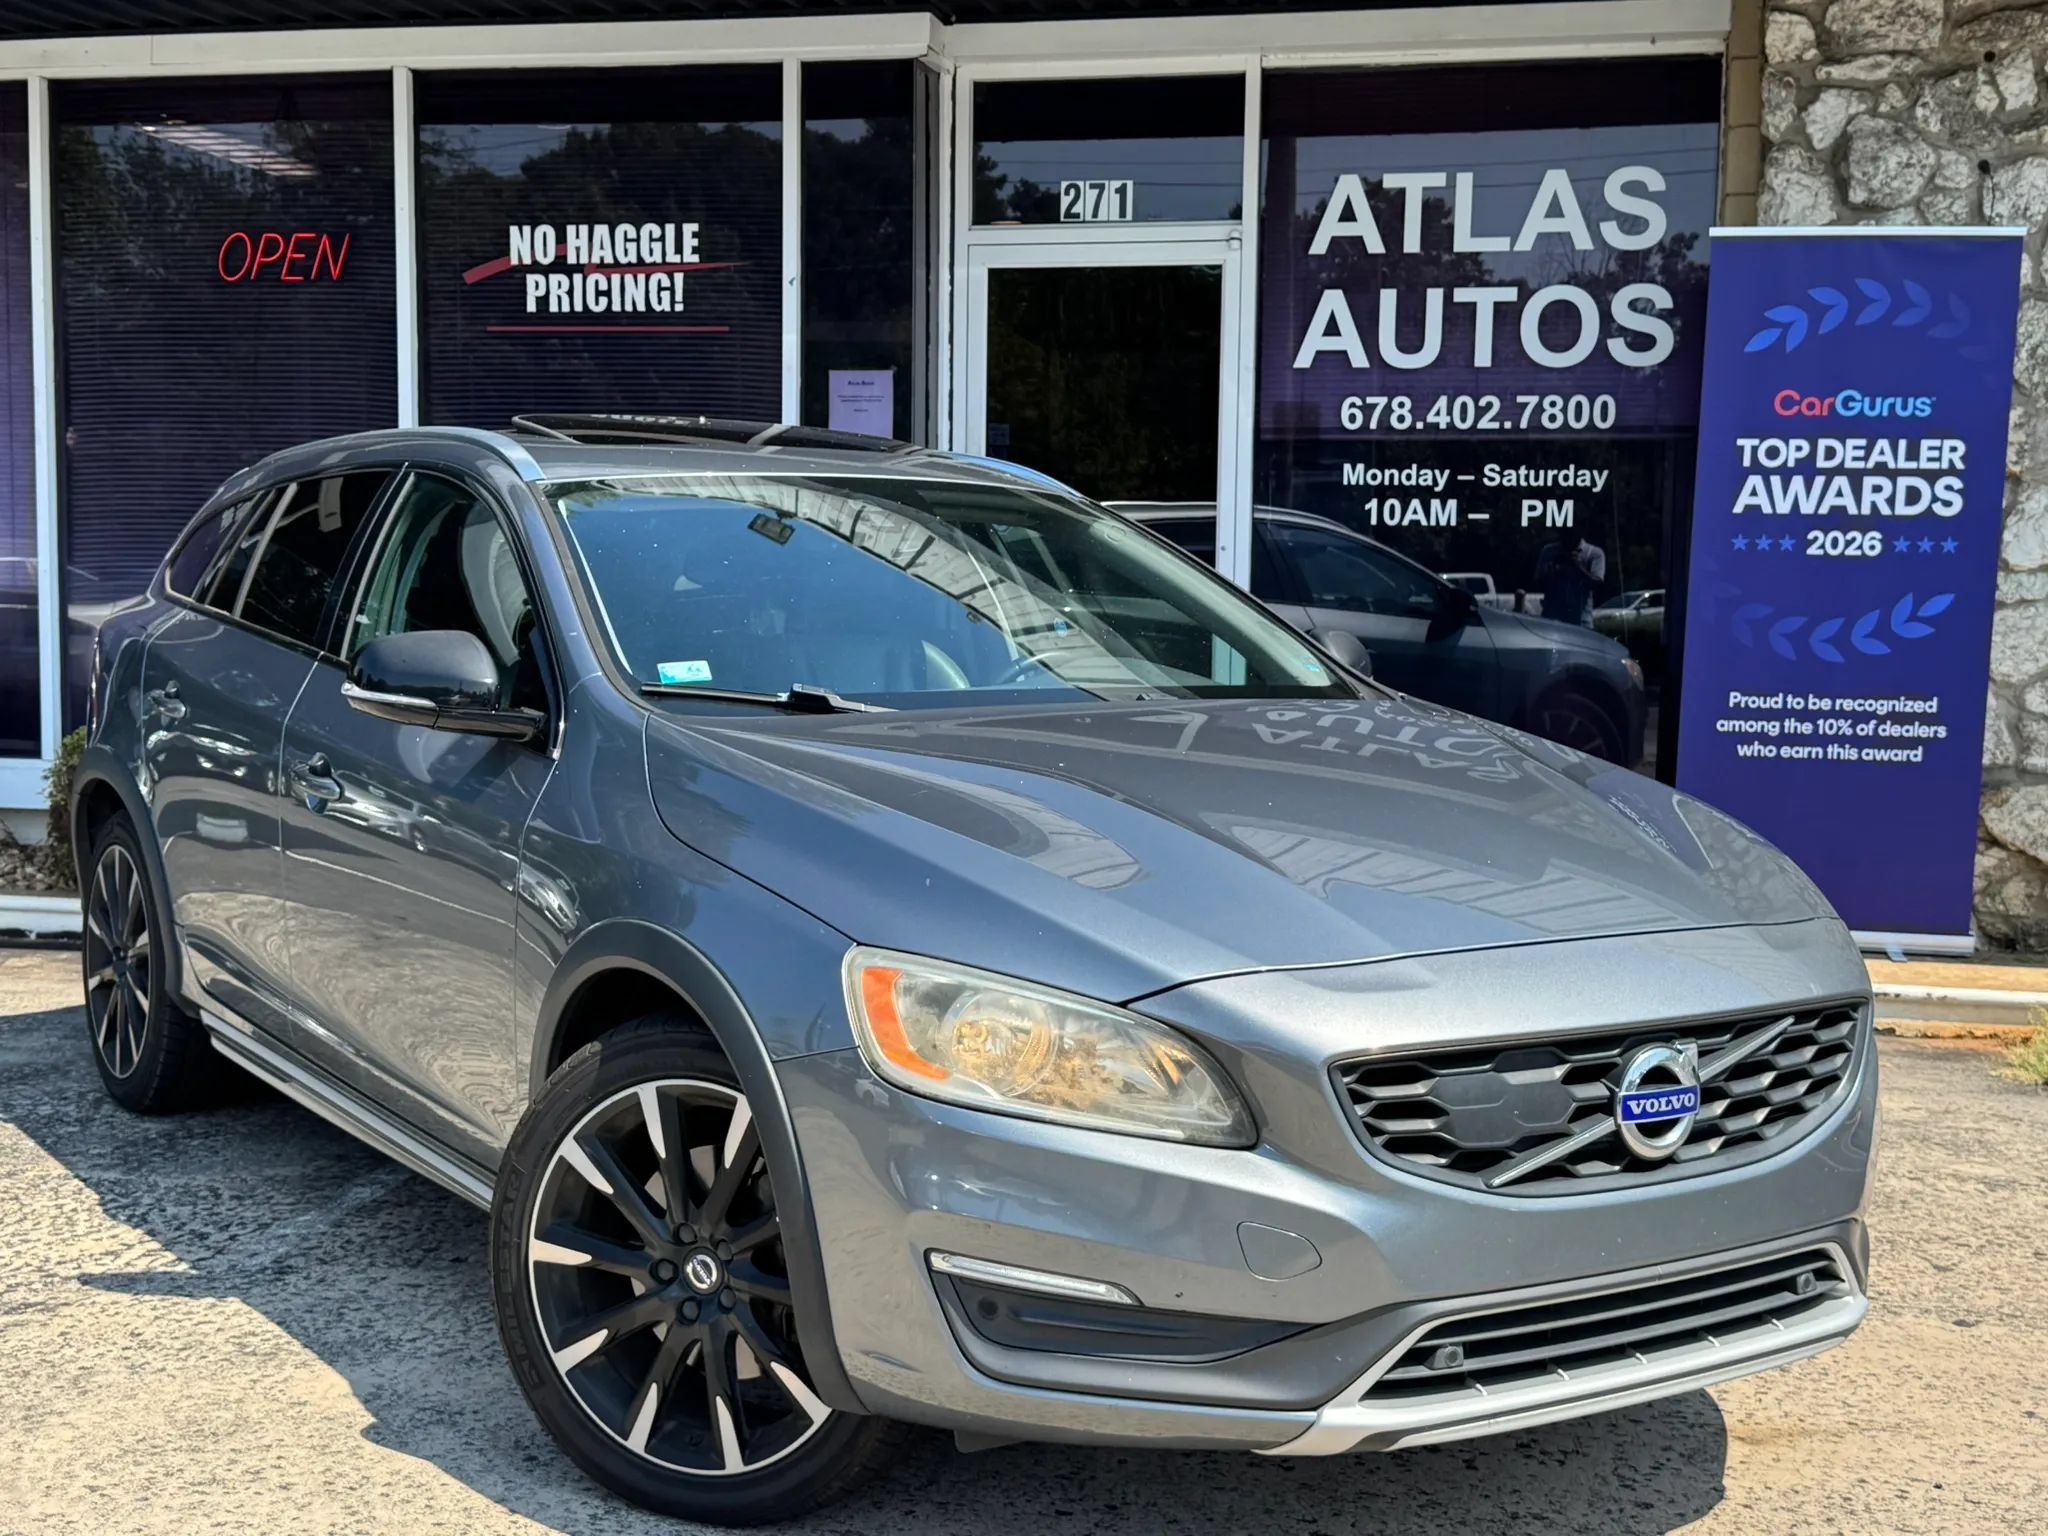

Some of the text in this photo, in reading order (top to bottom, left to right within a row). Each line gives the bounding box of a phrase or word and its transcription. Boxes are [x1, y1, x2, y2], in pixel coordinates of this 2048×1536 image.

[1063, 182, 1128, 219] 271
[1308, 165, 1668, 255] ATLAS
[218, 231, 349, 282] OPEN
[509, 222, 700, 265] NO HAGGLE
[525, 271, 685, 313] PRICING!
[1292, 282, 1675, 370] AUTOS
[1340, 394, 1617, 431] 678.402.7800
[1774, 389, 1932, 417] CarGurus
[1736, 437, 1966, 470] TOP DEALER
[1342, 462, 1451, 492] Monday
[1482, 463, 1609, 492] Saturday
[1732, 474, 1964, 517] AWARDS
[1364, 498, 1458, 527] 10AM
[1520, 499, 1574, 528] PM
[1805, 529, 1883, 557] 2026
[1728, 691, 1938, 716] Proud to be recognized
[1715, 717, 1948, 739] among the 10% of dealers
[1736, 740, 1924, 763] who earn this award
[1627, 1092, 1695, 1115] VOLVO
